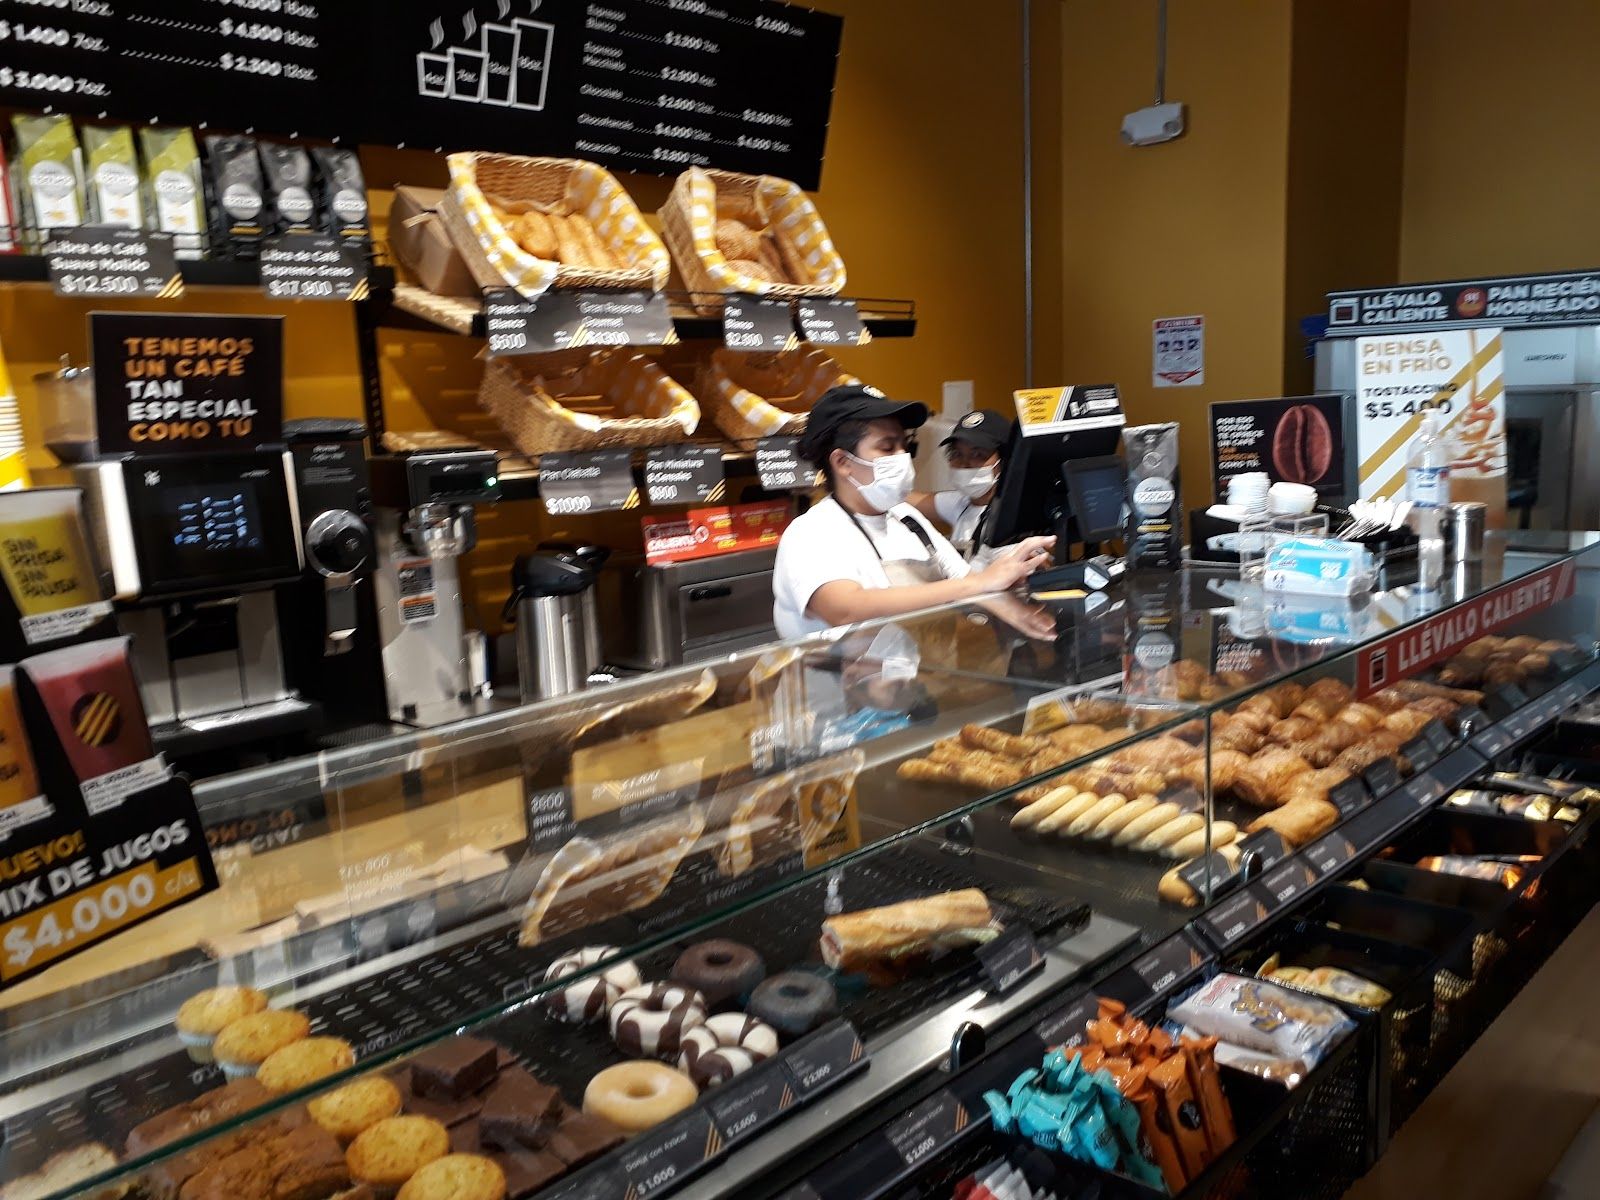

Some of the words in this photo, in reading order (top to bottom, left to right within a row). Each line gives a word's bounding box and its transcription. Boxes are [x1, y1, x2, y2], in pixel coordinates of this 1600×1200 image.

[1362, 291, 1443, 310] LLÉVALO
[1485, 283, 1531, 301] PAN
[1361, 306, 1450, 325] CALIENTE
[1485, 298, 1600, 317] HORNEADO
[122, 336, 255, 357] TENEMOS
[1362, 337, 1445, 358] PIENSA
[123, 357, 168, 378] UN
[173, 355, 246, 378] CAFÉ
[1362, 357, 1392, 376] EN
[1399, 354, 1453, 374] FRÍO
[124, 379, 185, 400] TAN
[127, 397, 259, 422] ESPECIAL
[127, 419, 212, 443] COMO
[1398, 606, 1478, 673] LLÉVALO
[1480, 574, 1553, 630] CALIENTE
[0, 829, 87, 883] UEVO!
[49, 855, 97, 897] DE
[99, 817, 191, 876] JUGOS
[3, 872, 156, 967] $4.000
[624, 1154, 649, 1174] Donut
